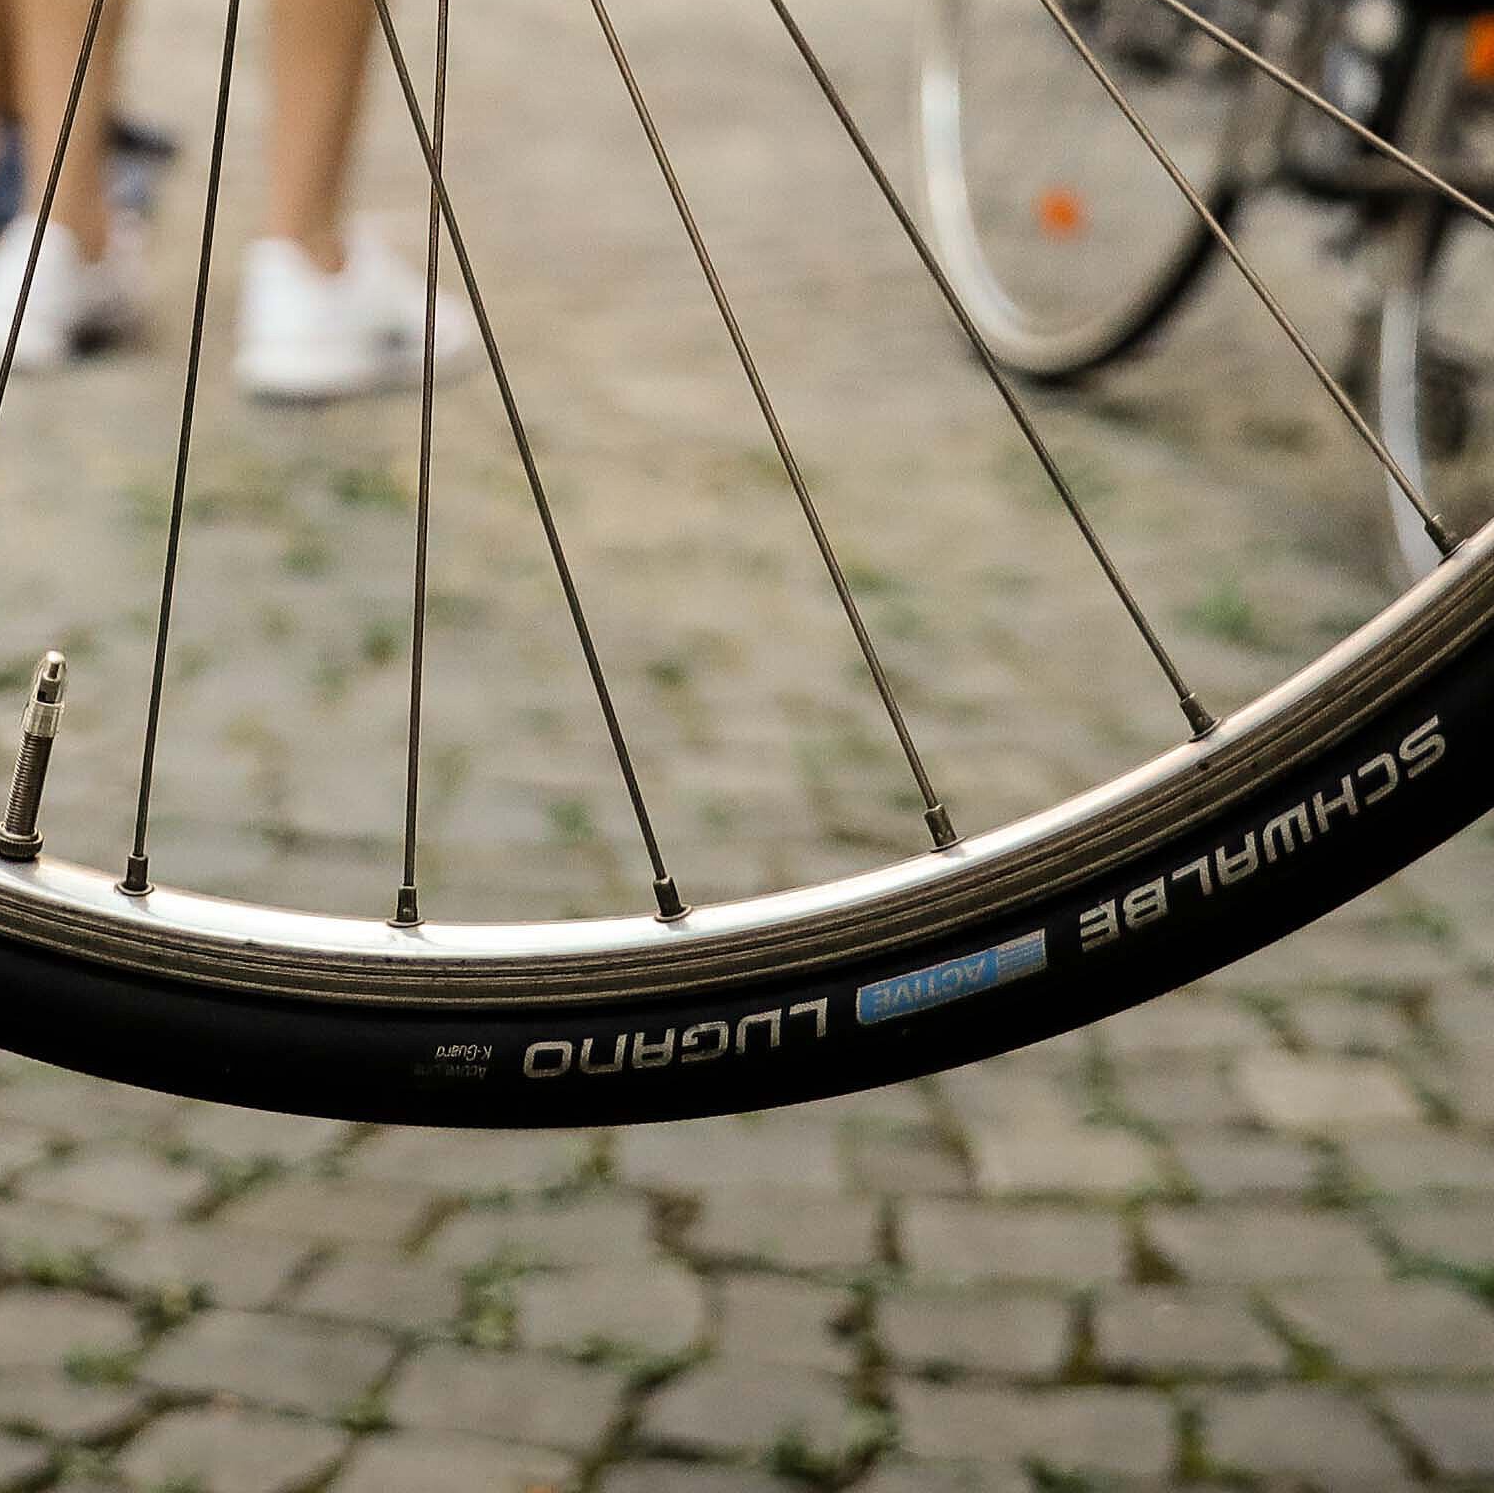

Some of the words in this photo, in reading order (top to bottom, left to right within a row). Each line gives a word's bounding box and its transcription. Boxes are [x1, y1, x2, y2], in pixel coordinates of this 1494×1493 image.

[1078, 714, 1447, 954] SCHWALBE
[871, 959, 986, 1013] ACTIVE
[433, 1043, 494, 1062] K-Guard
[522, 997, 829, 1081] LUGANO
